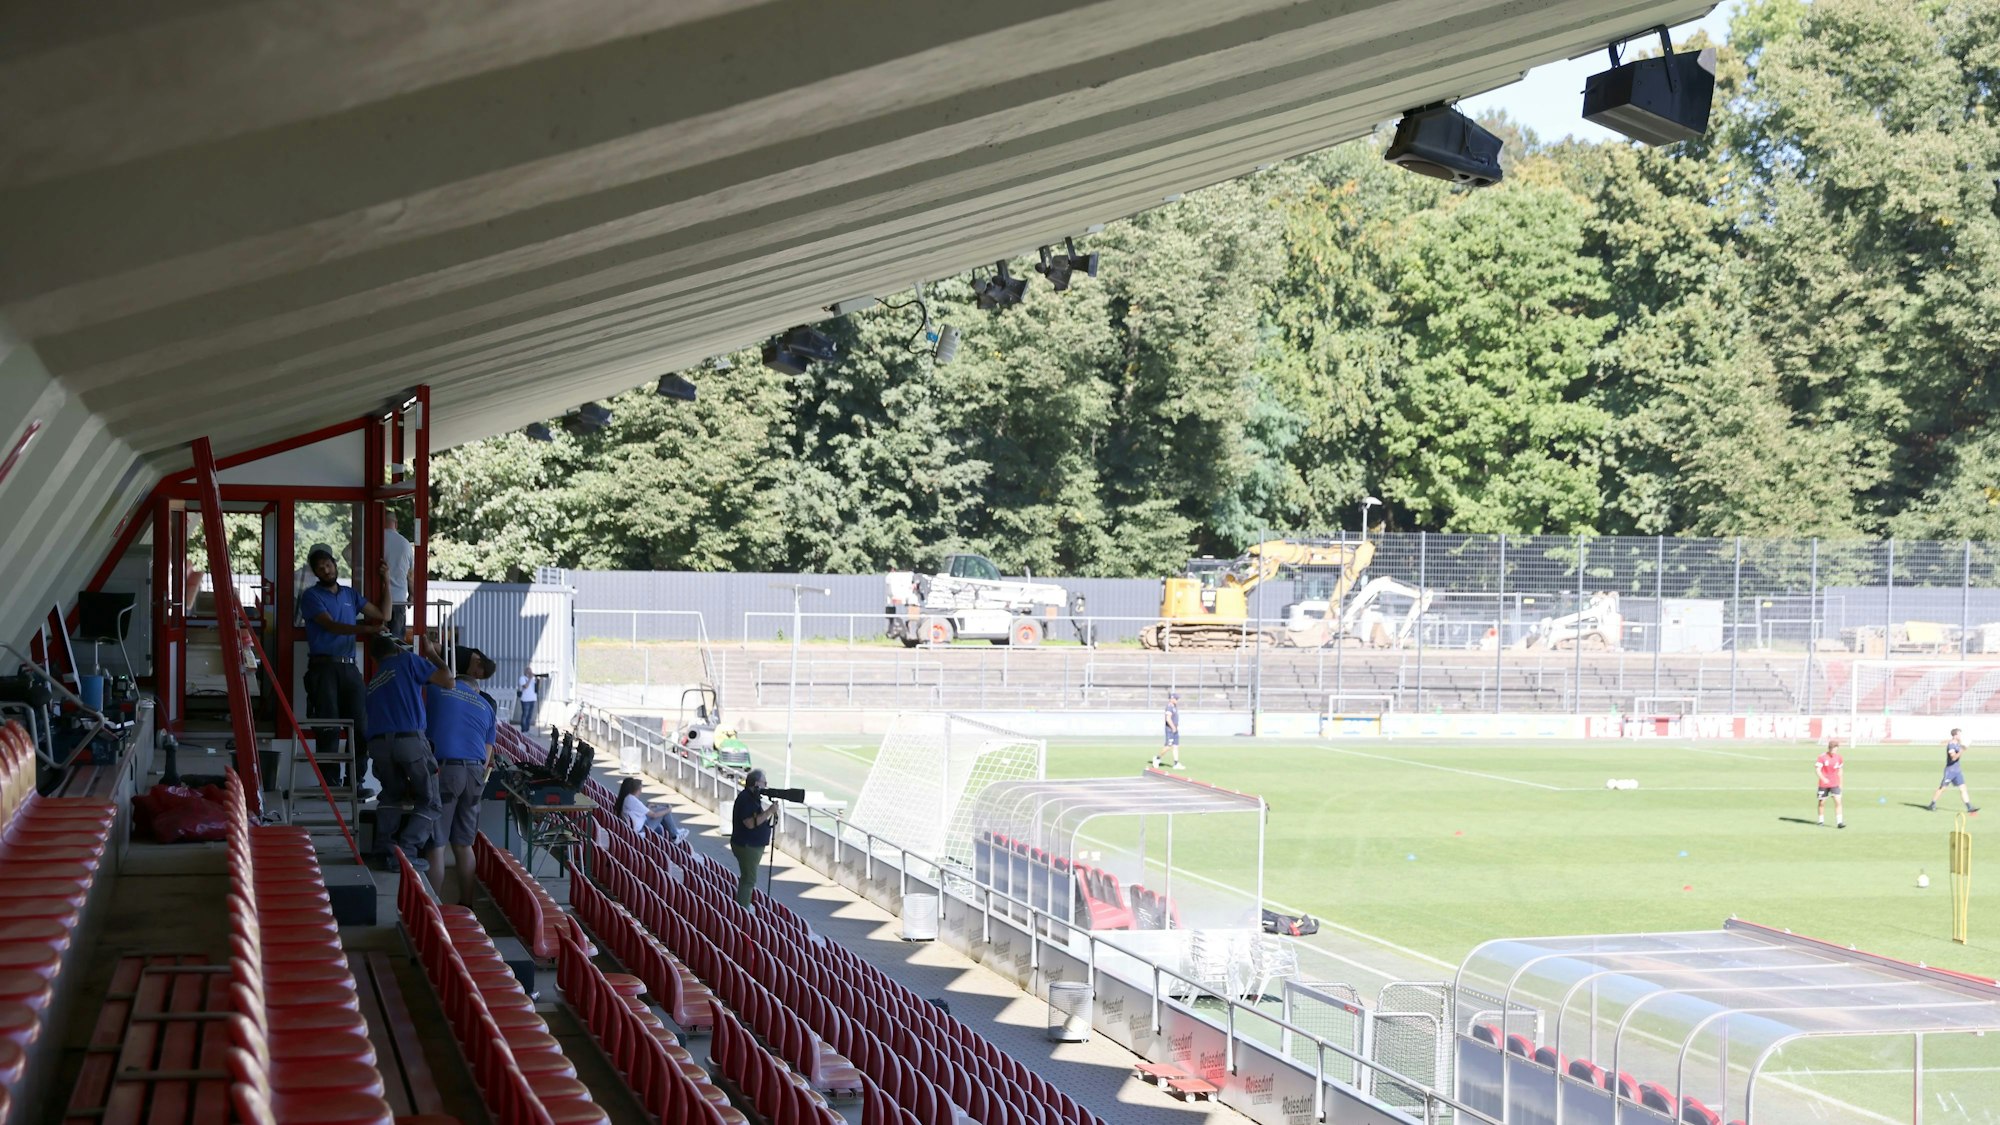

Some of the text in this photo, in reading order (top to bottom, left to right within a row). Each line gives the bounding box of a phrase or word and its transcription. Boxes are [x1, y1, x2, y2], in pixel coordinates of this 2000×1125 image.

[1590, 717, 1657, 738] REWE
[1746, 717, 1810, 738] REWE
[1822, 717, 1886, 738] REWE
[1167, 1031, 1193, 1053] Reissdorf
[1200, 1048, 1226, 1070] Reissdorf
[1245, 1072, 1274, 1094] Reissdorf
[1282, 1093, 1313, 1115] Reissdorf
